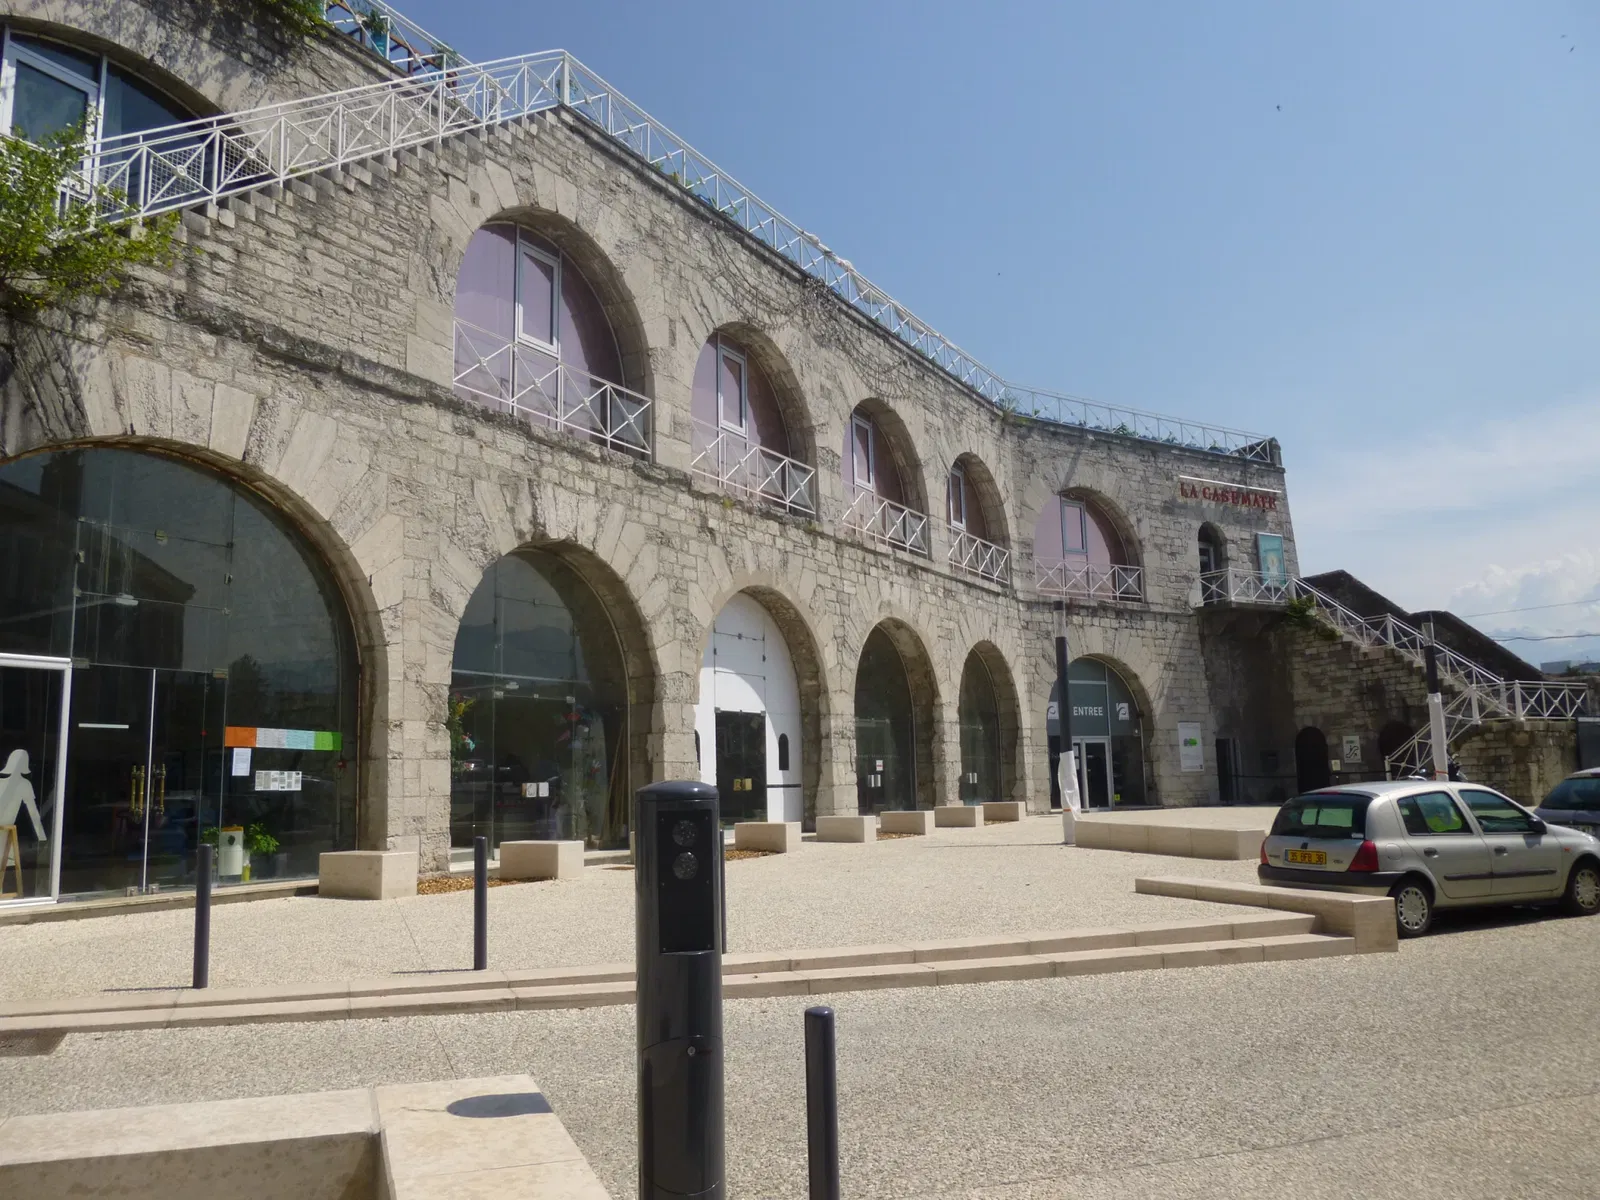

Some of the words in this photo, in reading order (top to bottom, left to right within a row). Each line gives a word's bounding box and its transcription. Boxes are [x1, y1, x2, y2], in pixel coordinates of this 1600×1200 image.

[1180, 482, 1198, 499] LA
[1202, 486, 1277, 510] CASEMATE
[1072, 706, 1104, 717] ENTREE
